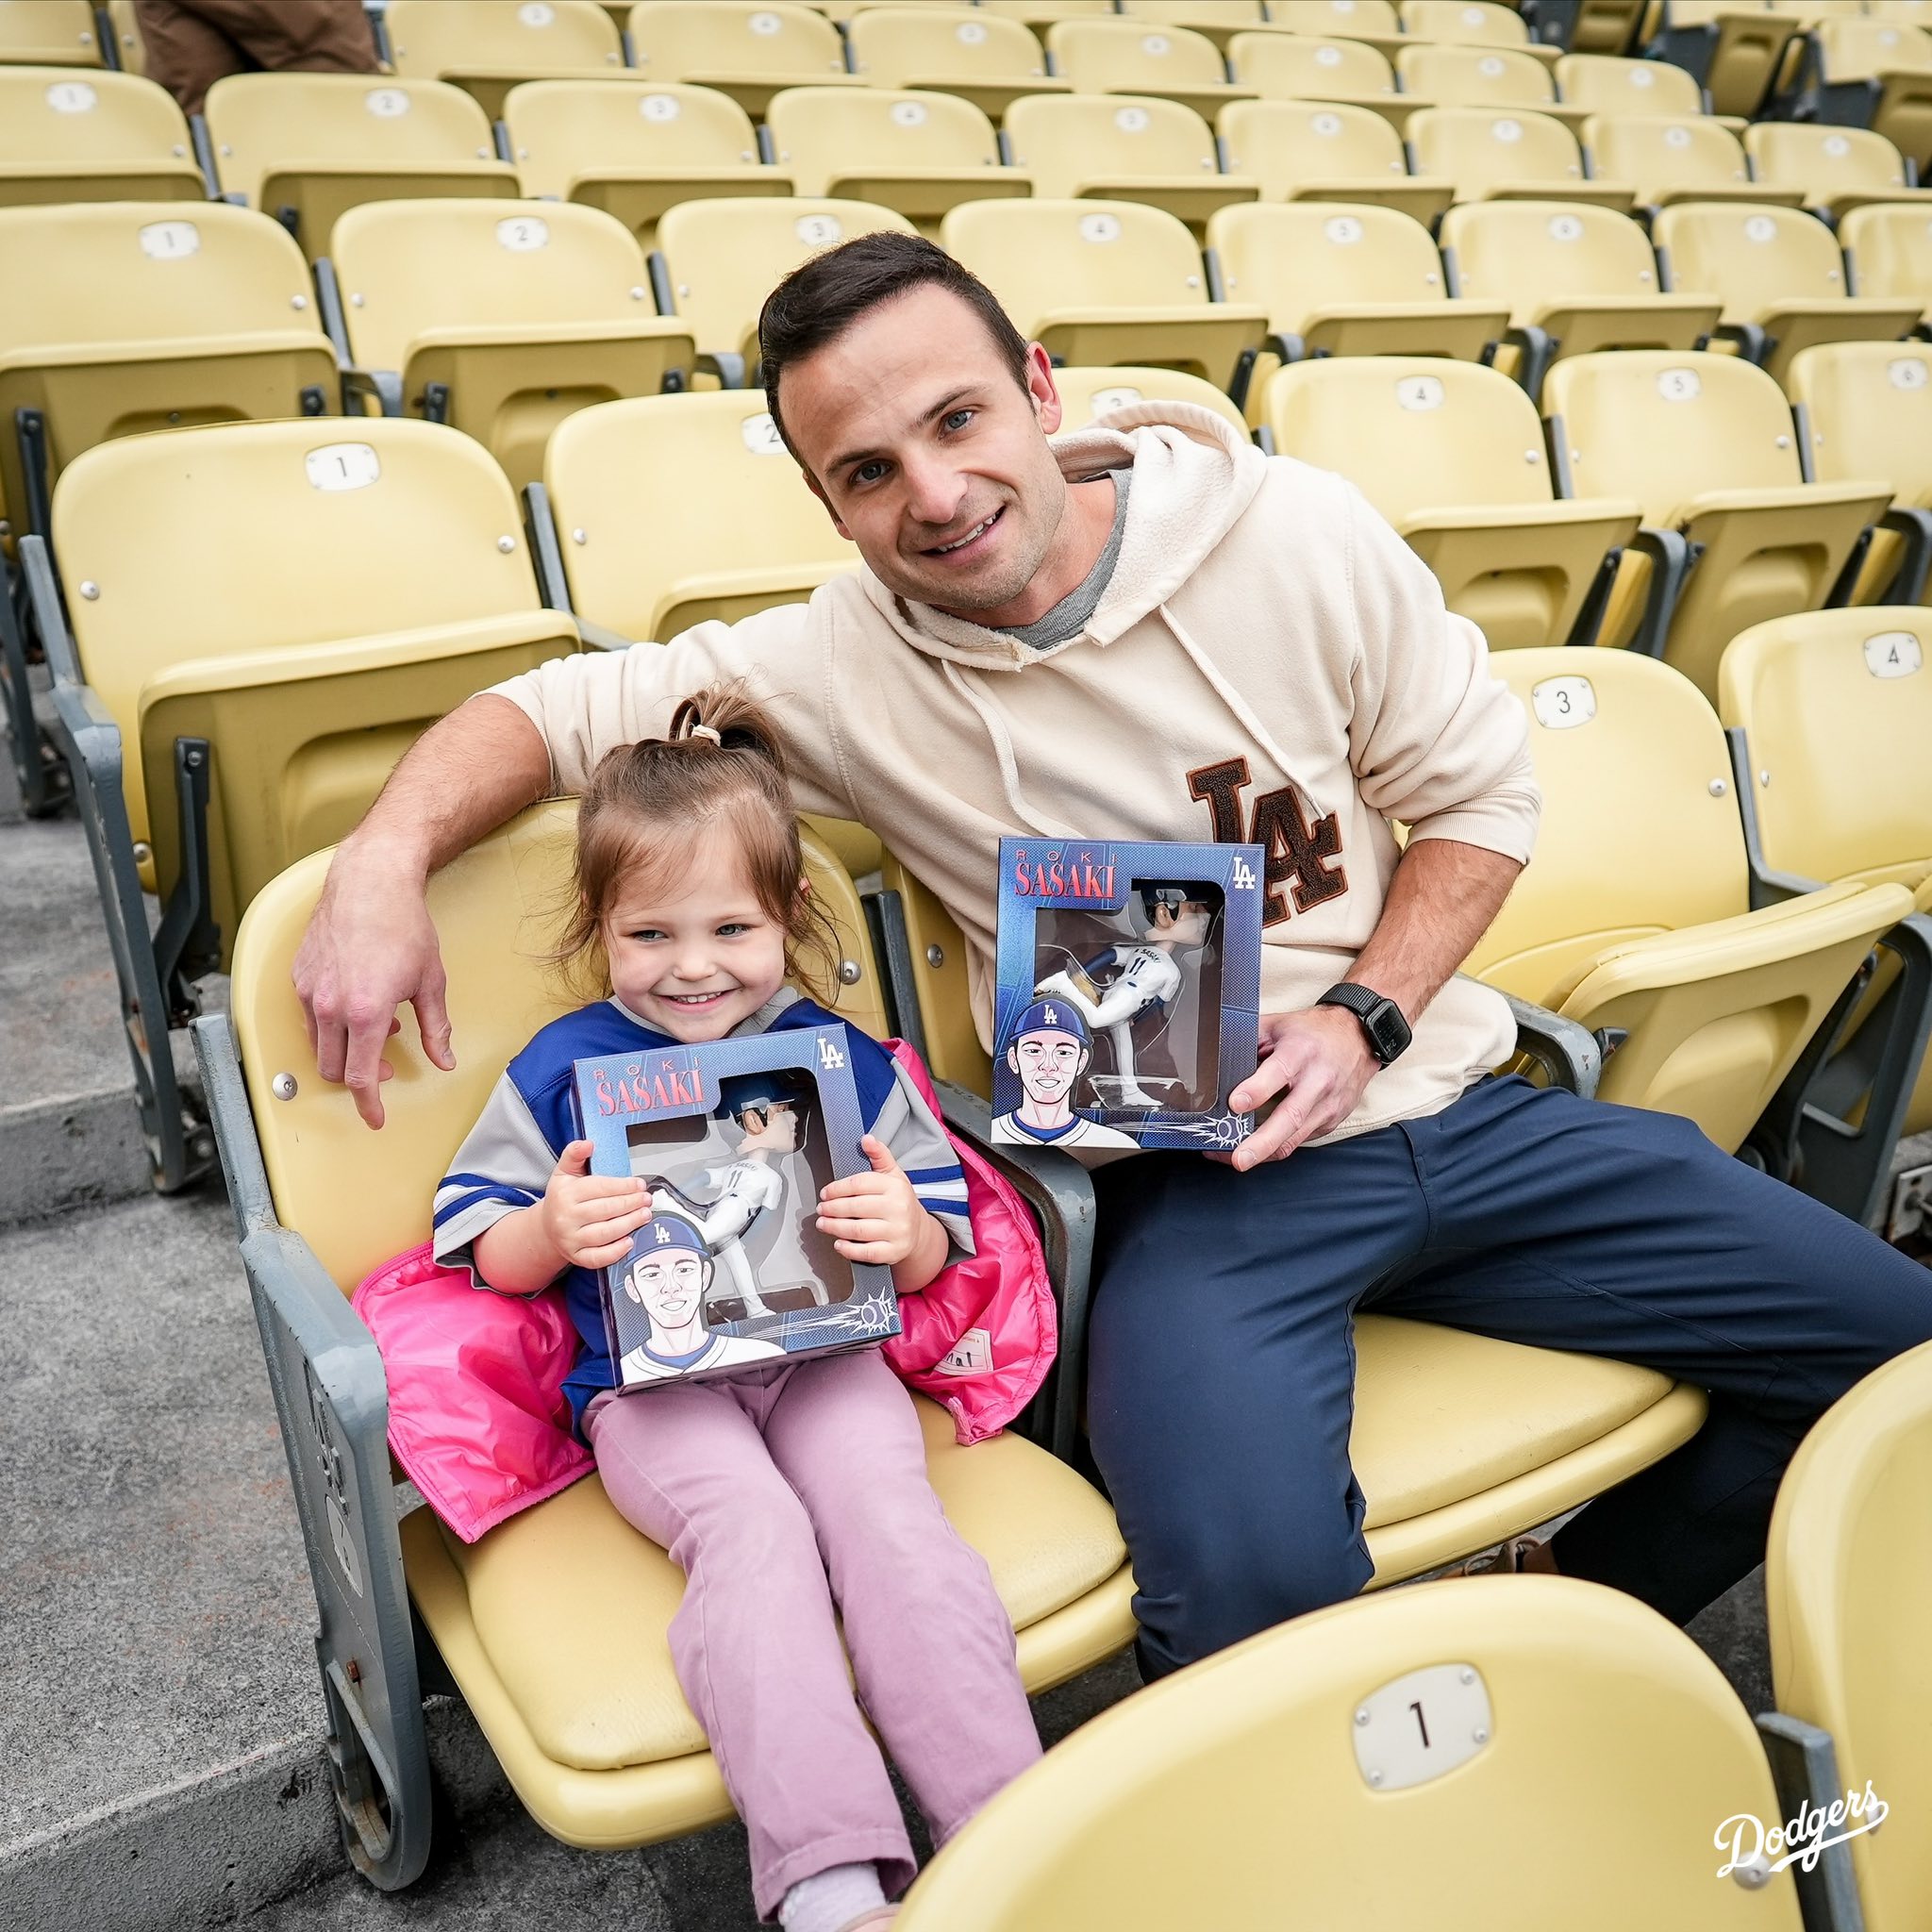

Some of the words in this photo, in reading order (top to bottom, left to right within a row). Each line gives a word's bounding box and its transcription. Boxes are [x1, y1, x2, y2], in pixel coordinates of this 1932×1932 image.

[381, 95, 393, 110] 2
[164, 230, 175, 248] 1
[514, 225, 529, 242] 2
[813, 221, 825, 238] 3
[1415, 385, 1426, 401] 4
[1674, 375, 1685, 392] 5
[765, 424, 780, 442] 2
[336, 457, 347, 478] 1
[1888, 642, 1900, 664] 4
[1557, 691, 1571, 714] 3
[1015, 862, 1116, 899] SASAKI
[1232, 857, 1256, 890] LA
[1129, 957, 1147, 975] 11
[1043, 1004, 1058, 1024] LA
[817, 1038, 845, 1070] LA
[596, 1070, 704, 1116] SASAKI
[727, 1170, 743, 1189] 11
[654, 1223, 671, 1243] LA
[1408, 1701, 1431, 1749] 1
